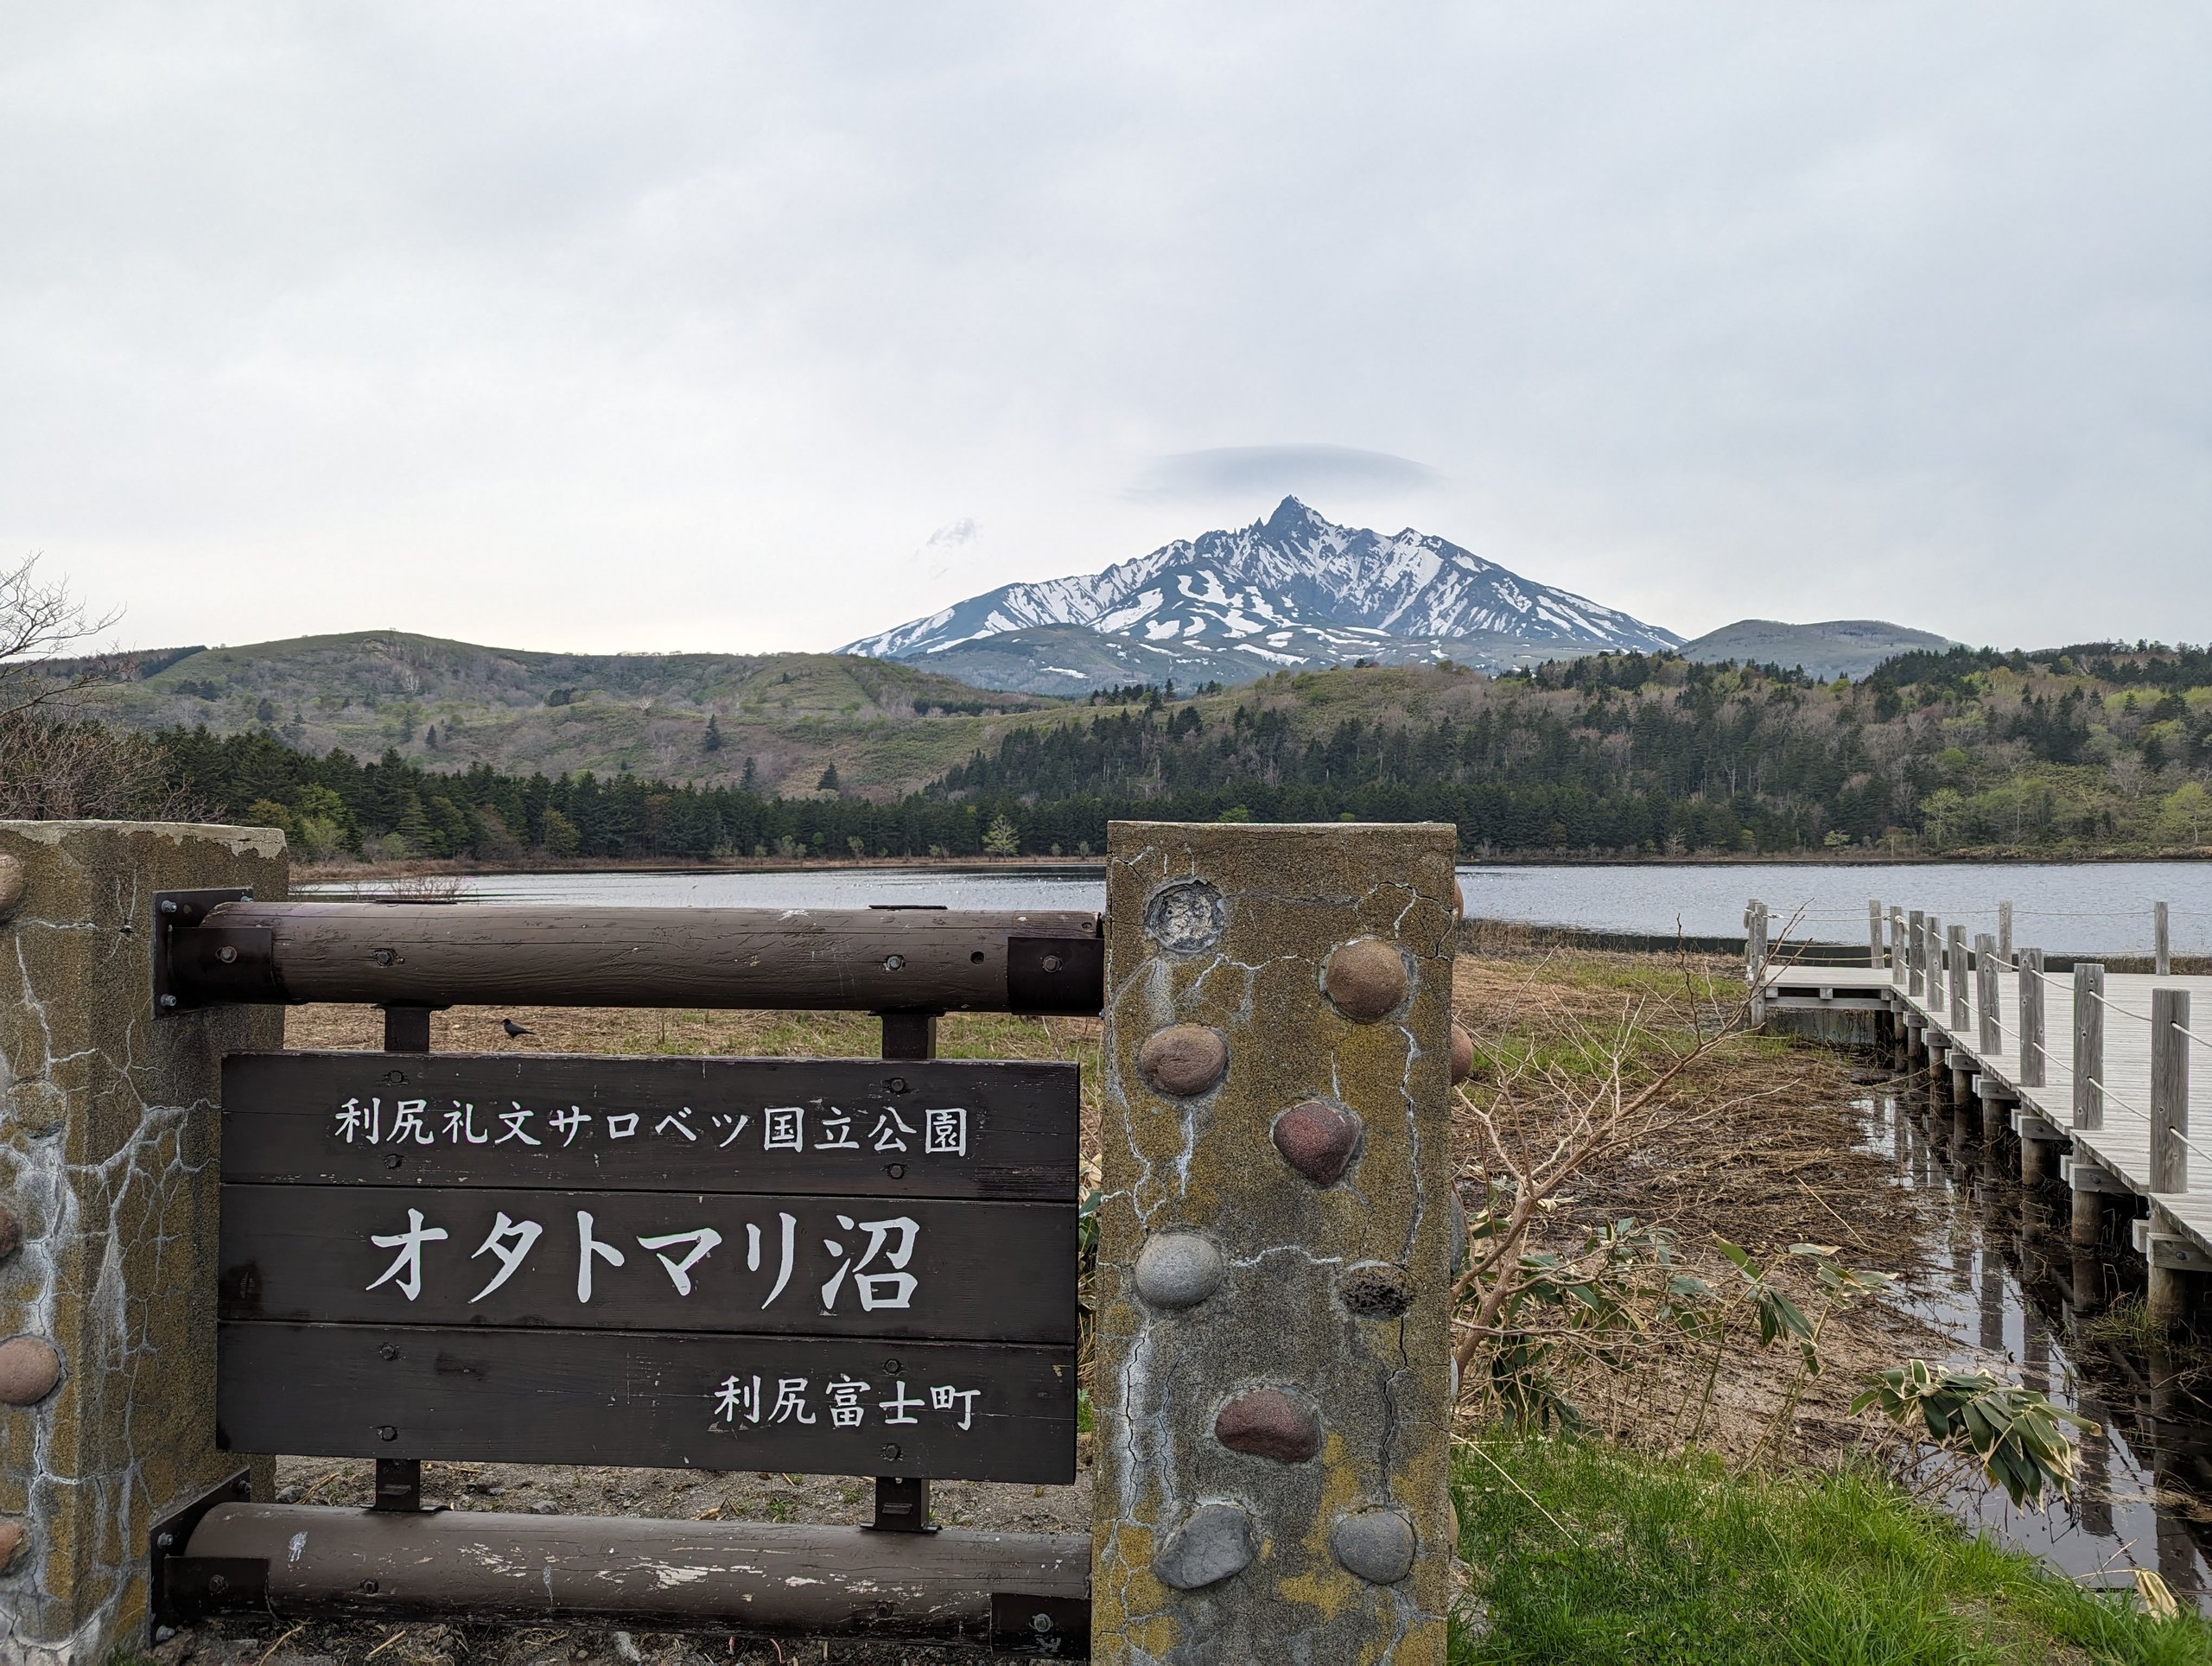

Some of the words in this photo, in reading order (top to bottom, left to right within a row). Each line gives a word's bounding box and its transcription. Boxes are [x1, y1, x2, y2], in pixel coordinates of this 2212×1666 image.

[334, 1097, 968, 1157] 利尻礼文サロベツ国立公園
[365, 1208, 920, 1313] オタトマリ沼
[714, 1374, 982, 1431] 利尻富士町
